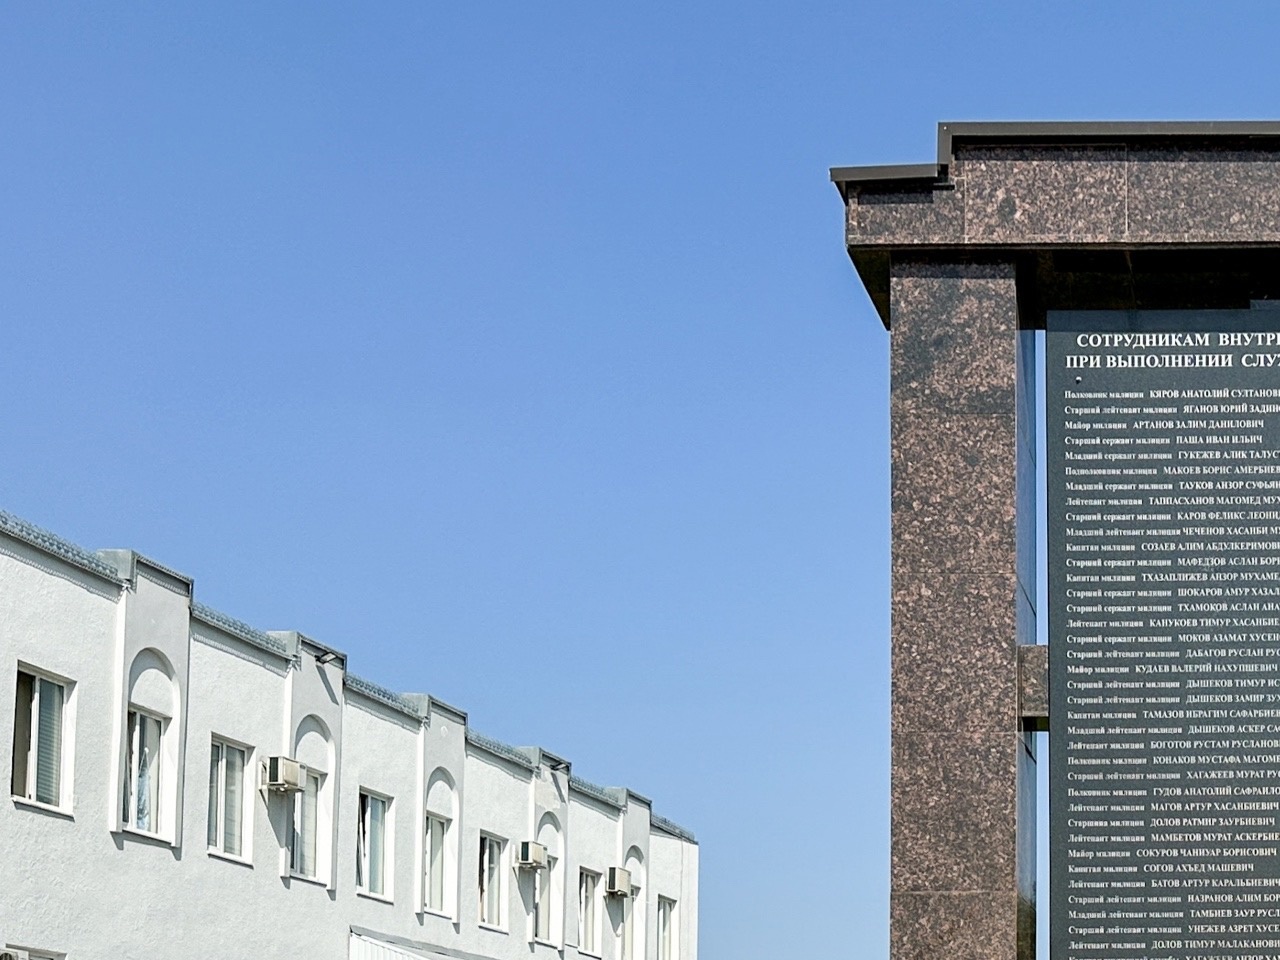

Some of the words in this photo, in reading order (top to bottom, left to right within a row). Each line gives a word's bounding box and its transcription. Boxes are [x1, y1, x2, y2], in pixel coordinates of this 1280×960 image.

[1076, 333, 1210, 349] СОТРУДНИКАМ
[1066, 354, 1101, 368] ПРИ
[1105, 353, 1233, 368] ВЫПОЛНЕНИИ
[1149, 389, 1180, 399] КЯРОВ
[1180, 387, 1230, 399] АНАТОЛИЙ
[1183, 404, 1219, 414] ЯГАНОВ
[1220, 402, 1248, 414] ЮРИЙ
[1133, 420, 1174, 430] АРТАНОВ
[1175, 419, 1207, 429] ЗАЛИМ
[1208, 419, 1264, 430] ДАНИЛОВИЧ
[1176, 435, 1204, 445] ПАША
[1205, 435, 1230, 445] ИВАН
[1231, 434, 1263, 444] ИЛЬИЧ
[1178, 450, 1221, 460] ГУКЕЖЕВ
[1222, 450, 1248, 460] АЛИК
[1163, 465, 1201, 475] МАКОЕВ
[1202, 465, 1233, 475] БОРИС
[1179, 480, 1214, 490] ТАУКОВ
[1215, 480, 1244, 490] АНЗОР
[1149, 496, 1215, 506] ТАППАСХАНОВ
[1216, 495, 1261, 506] МАГОМЕД
[1177, 511, 1207, 521] КАРОВ
[1208, 511, 1246, 521] ФЕЛИКС
[1182, 526, 1225, 536] ЧЕЧЕНОВ
[1141, 542, 1176, 552] СОЗАЕВ
[1177, 541, 1204, 551] АЛИМ
[1177, 556, 1226, 567] МАФЕДЗОВ
[1228, 556, 1258, 566] АСЛАН
[1209, 572, 1239, 582] АНЗОР
[1177, 587, 1223, 597] ШОКАРОВ
[1224, 587, 1250, 597] АМУР
[1178, 602, 1228, 613] ТХАМОКОВ
[1229, 602, 1260, 612] АСЛАН
[1149, 618, 1198, 628] КАНУКОЕВ
[1199, 617, 1231, 627] ТИМУР
[1178, 633, 1211, 643] МОКОВ
[1212, 633, 1247, 643] АЗАМАТ
[1185, 648, 1227, 659] ДАБАГОВ
[1228, 648, 1264, 658] РУСЛАН
[1135, 664, 1170, 675] КУДАЕВ
[1171, 662, 1212, 673] ВАЛЕРИЙ
[1214, 663, 1278, 673] НАХУПШЕВИЧ
[1185, 678, 1233, 689] ДЫШЕКОВ
[1234, 678, 1266, 688] ТИМУР
[1186, 694, 1233, 705] ДЫШЕКОВ
[1234, 693, 1265, 703] ЗАМИР
[1142, 709, 1185, 719] ТАМАЗОВ
[1185, 709, 1228, 719] ИБРАГИМ
[1187, 724, 1235, 735] ДЫШЕКОВ
[1237, 724, 1266, 734] АСКЕР
[1150, 740, 1192, 750] БОГОТОВ
[1193, 739, 1230, 749] РУСТАМ
[1153, 755, 1196, 765] КОНАКОВ
[1197, 754, 1241, 765] МУСТАФА
[1186, 770, 1235, 780] ХАГАЖЕЕВ
[1236, 769, 1265, 779] МУРАТ
[1153, 787, 1182, 797] ГУДОВ
[1183, 785, 1232, 796] АНАТОЛИЙ
[1150, 802, 1182, 812] МАГОВ
[1184, 802, 1212, 812] АРТУР
[1213, 801, 1280, 811] ХАСАНБИЕВИЧ
[1150, 817, 1181, 828] ДОЛОВ
[1182, 817, 1217, 827] РАТМИР
[1218, 816, 1276, 827] ЗАУРБИЕВИЧ
[1151, 832, 1202, 842] МАМБЕТОВ
[1203, 832, 1233, 842] МУРАТ
[1136, 848, 1179, 858] СОКУРОВ
[1222, 847, 1277, 857] БОРИСОВИЧ
[1143, 863, 1174, 873] СОГОВ
[1175, 863, 1206, 873] АХЪЕД
[1207, 862, 1254, 872] МАШЕВИЧ
[1151, 878, 1180, 888] БАТОВ
[1181, 878, 1210, 888] АРТУР
[1187, 893, 1234, 903] НАЗРАНОВ
[1235, 893, 1262, 903] АЛИМ
[1190, 908, 1233, 918] ТАМБИЕВ
[1234, 908, 1256, 918] ЗАУР
[1188, 924, 1226, 934] УНЕЖЕВ
[1228, 924, 1253, 933] АЗРЕТ
[1151, 939, 1183, 950] ДОЛОВ
[1184, 939, 1216, 949] ТИМУР
